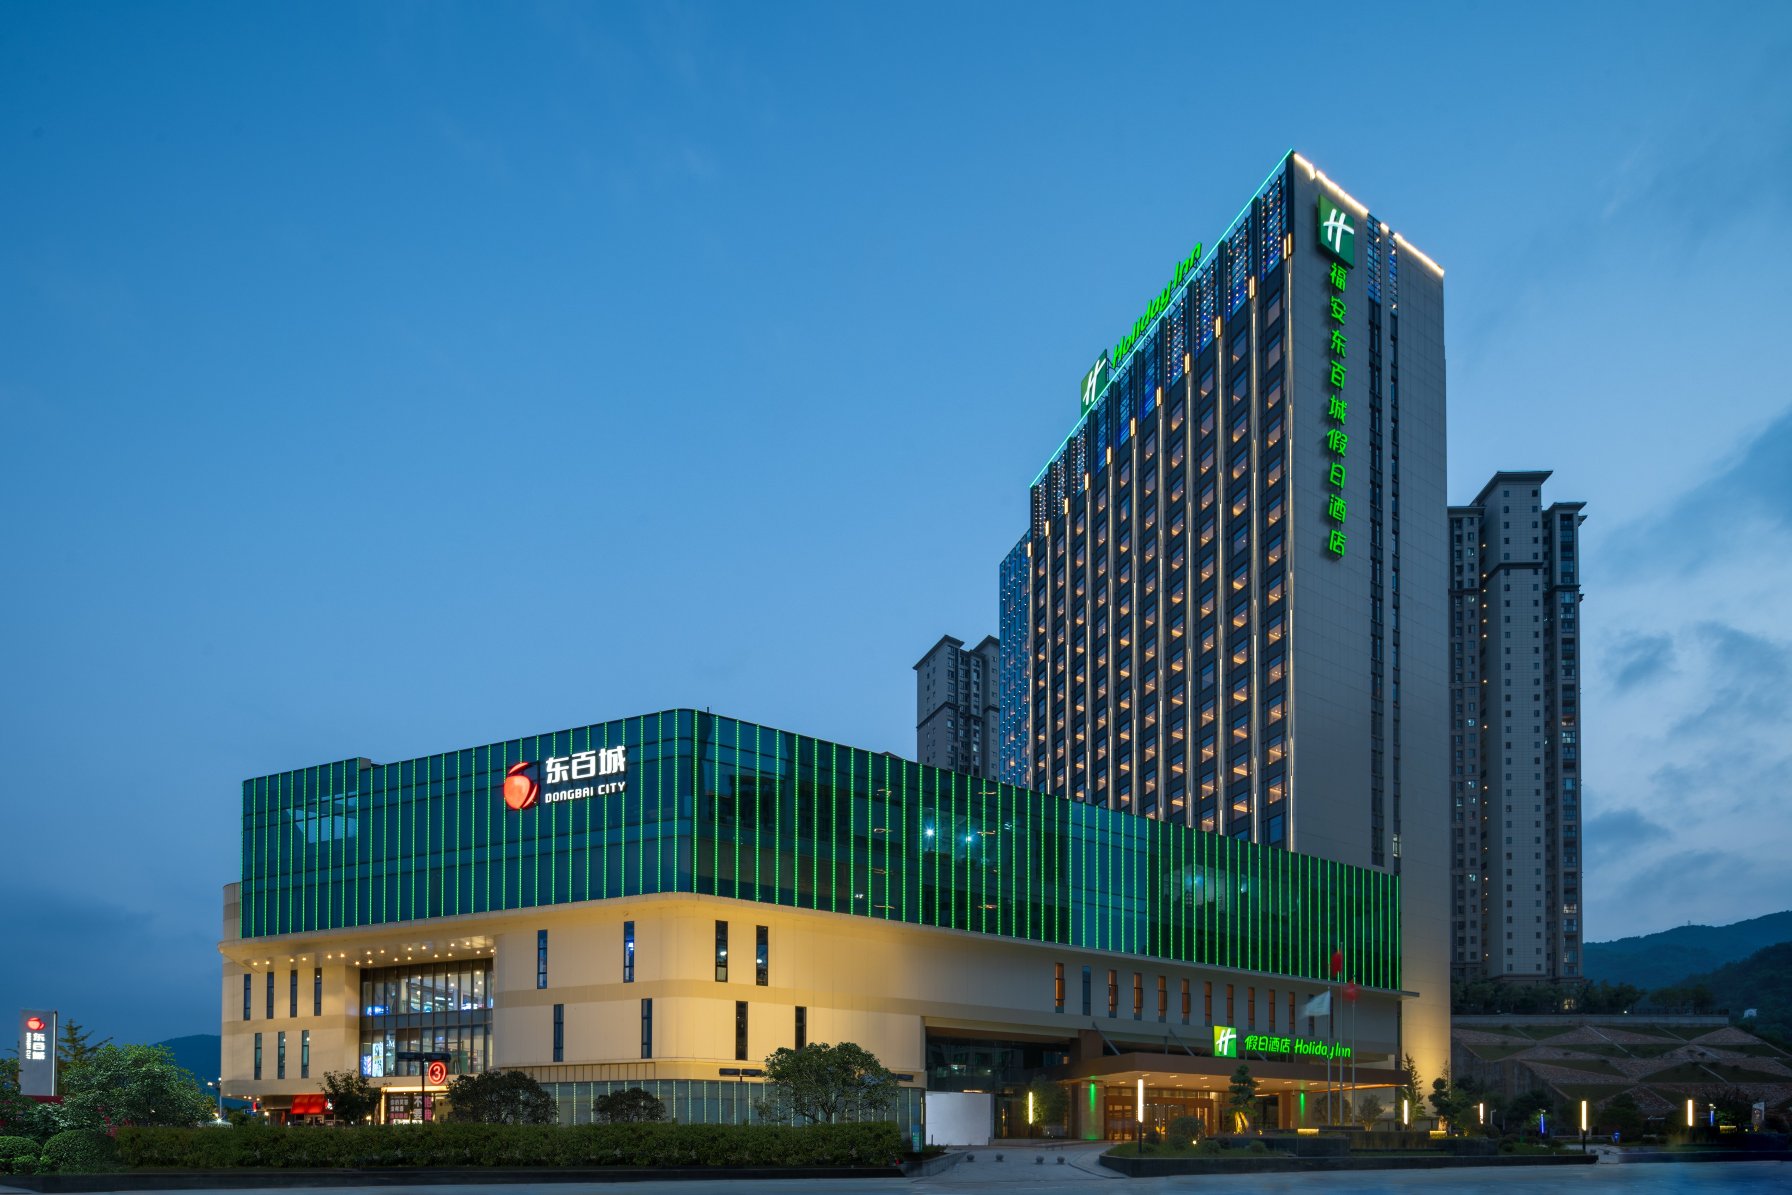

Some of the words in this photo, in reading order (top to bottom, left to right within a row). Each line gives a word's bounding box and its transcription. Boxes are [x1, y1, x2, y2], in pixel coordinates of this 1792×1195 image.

[1112, 280, 1173, 369] Holiday
[1173, 242, 1202, 289] Inn
[1327, 262, 1349, 556] 福安东百城假日酒店
[545, 745, 626, 785] 东百城
[545, 786, 594, 804] DONGBAI
[598, 781, 626, 795] CITY
[1244, 1035, 1291, 1054] 假日酒店
[1294, 1038, 1335, 1060] Holiday
